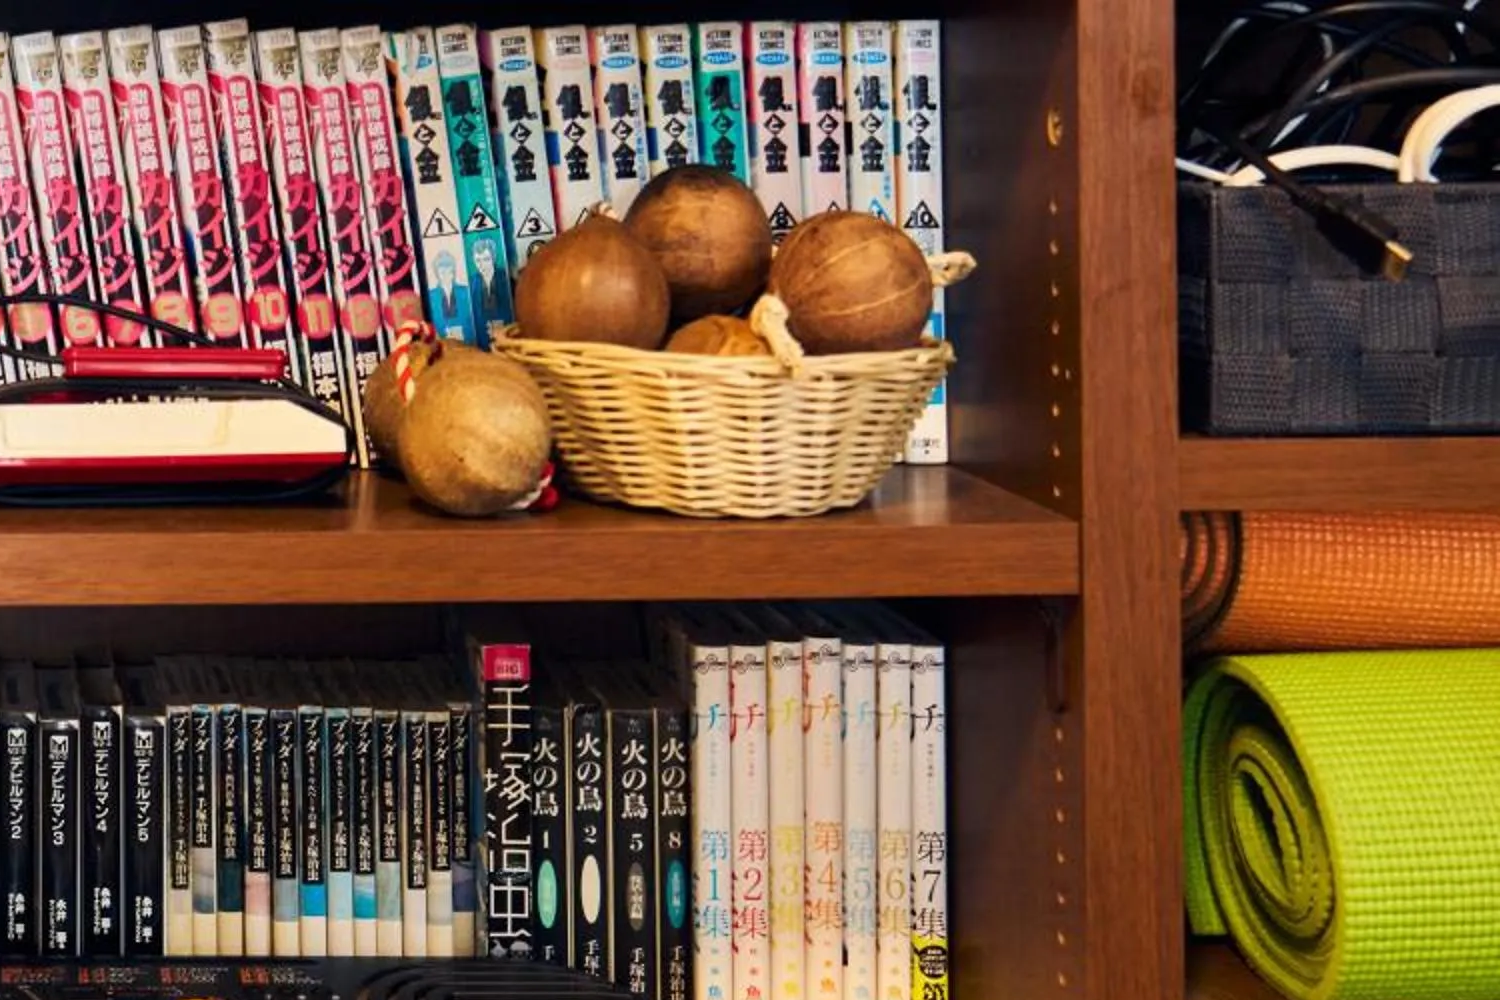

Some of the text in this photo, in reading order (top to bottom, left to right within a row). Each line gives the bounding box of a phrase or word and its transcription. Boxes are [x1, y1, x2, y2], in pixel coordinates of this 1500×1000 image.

[43, 176, 91, 294] カイジ
[140, 172, 186, 288] カイジ
[190, 172, 235, 289] カイジ
[237, 162, 282, 279] カイジ
[283, 174, 327, 290] カイジ
[370, 170, 416, 290] カイジ
[195, 715, 209, 751] ブッダ
[251, 717, 267, 753] ブッダ
[304, 717, 320, 753] ブッダ
[381, 721, 398, 757] ブッダ
[433, 725, 449, 766] ブッダ
[576, 732, 602, 844] 火の鳥 2
[484, 684, 532, 937] 手塚治虫
[533, 737, 559, 848] 火の鳥 1
[621, 739, 648, 851] 火の鳥 5
[661, 737, 686, 849] 火の鳥 8
[702, 829, 730, 938] 第1集
[738, 829, 767, 939] 第2集
[812, 820, 842, 930] 第4集
[881, 829, 909, 937] 第6集
[916, 830, 945, 939] 第7集
